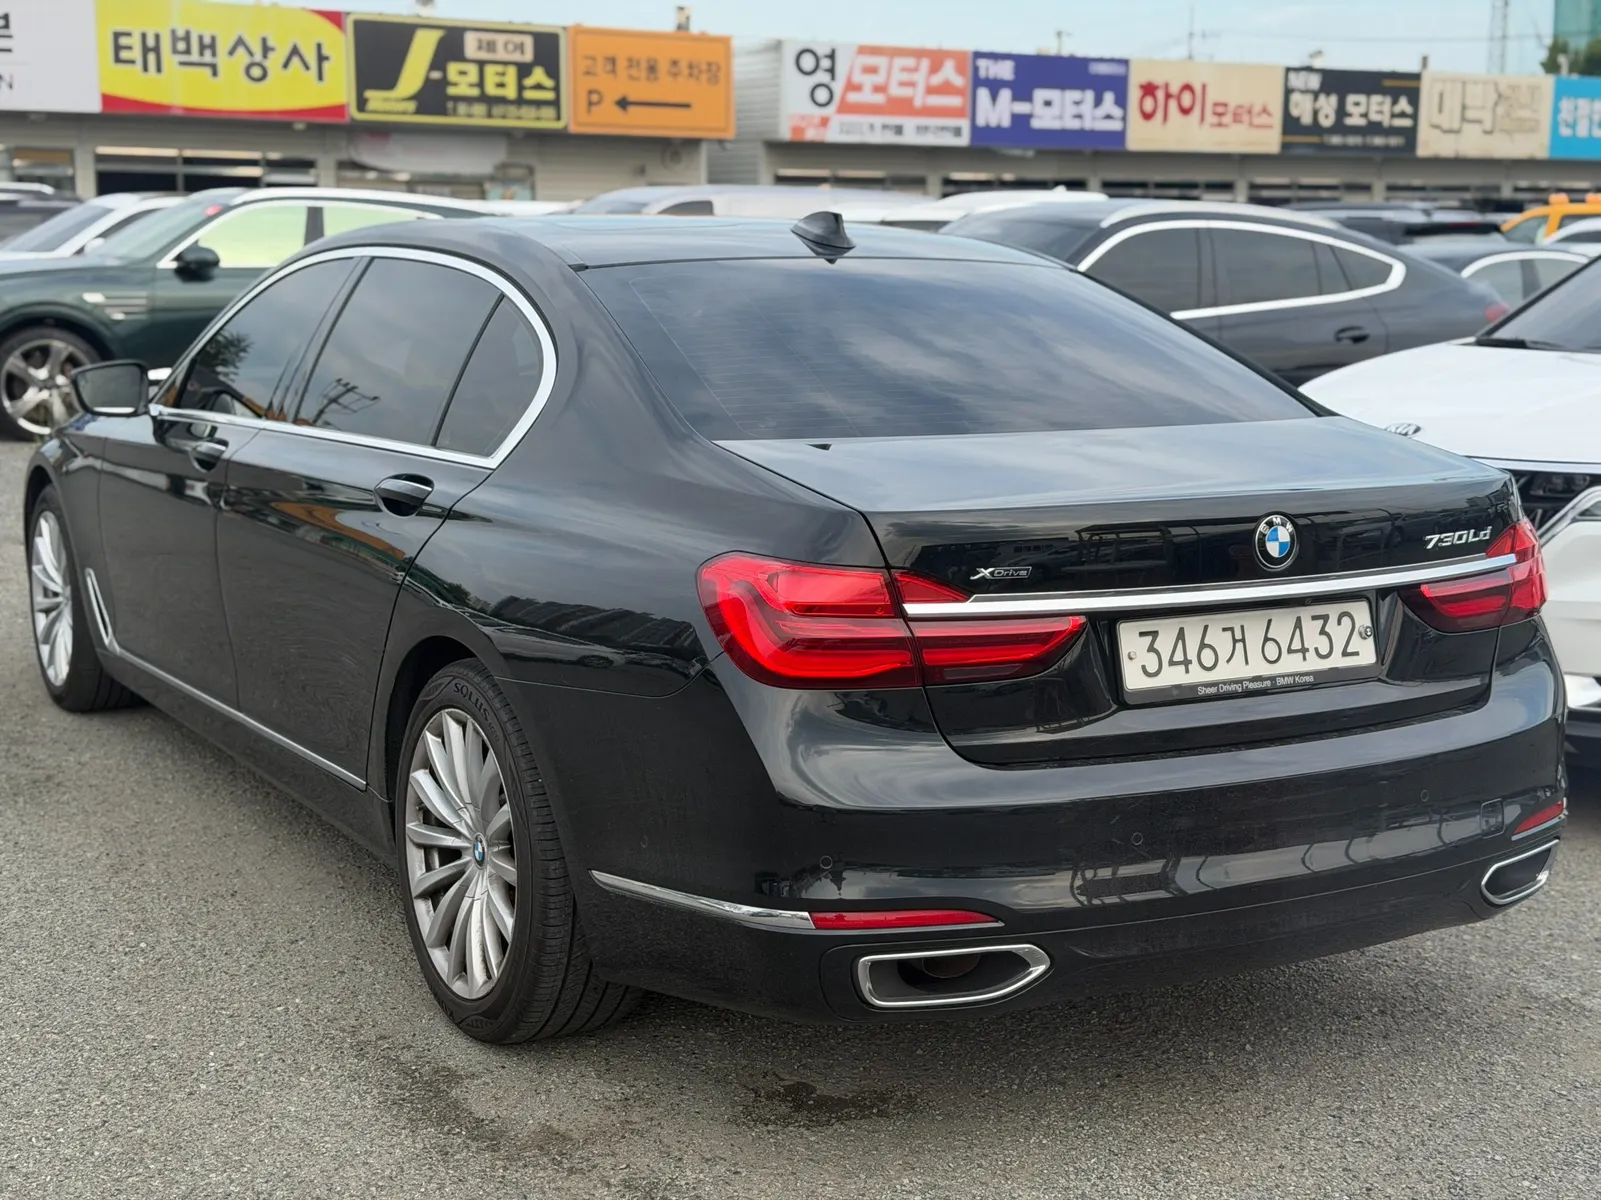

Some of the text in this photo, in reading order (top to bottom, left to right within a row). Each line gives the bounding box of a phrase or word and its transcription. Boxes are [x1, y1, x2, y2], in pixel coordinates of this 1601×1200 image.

[112, 29, 331, 83] 태백상사
[976, 58, 1015, 81] THE
[586, 89, 604, 115] P
[1343, 93, 1414, 128] 모터스
[1424, 526, 1493, 549] 730Ld
[1261, 611, 1360, 665] 6432
[1197, 674, 1314, 695] Sheer Driving Pleasure BMW Korea
[453, 682, 491, 722] SOLUS
